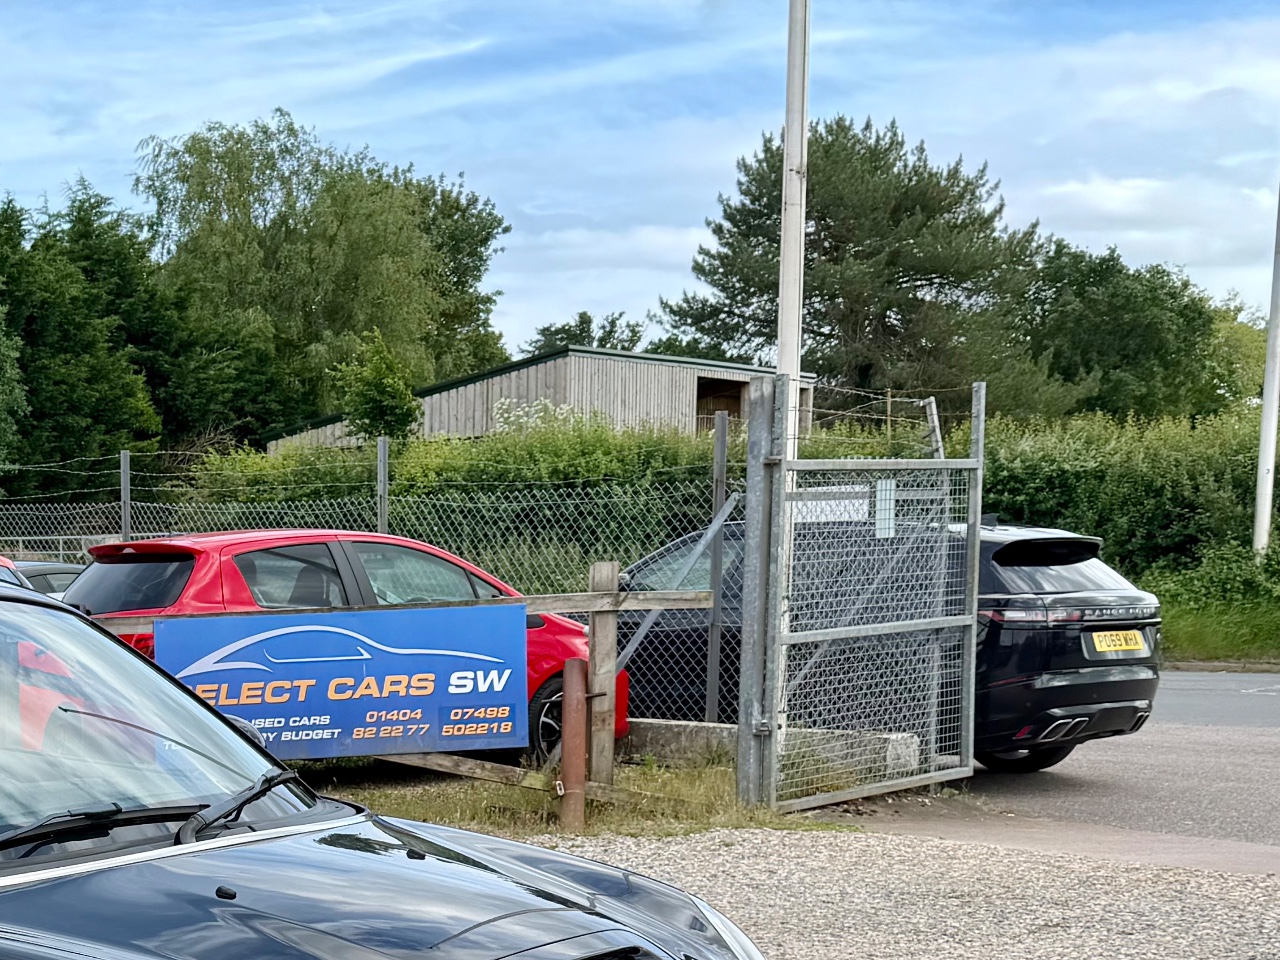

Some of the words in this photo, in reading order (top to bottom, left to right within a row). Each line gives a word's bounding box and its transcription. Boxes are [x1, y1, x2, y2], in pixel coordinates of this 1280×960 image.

[188, 679, 317, 706] ELECT
[327, 673, 436, 700] CARS
[447, 669, 512, 694] SW
[365, 709, 423, 723] 01404
[450, 706, 510, 720] 07498
[289, 715, 331, 727] CARS
[280, 728, 342, 741] BUDGET
[441, 721, 513, 736] 502218
